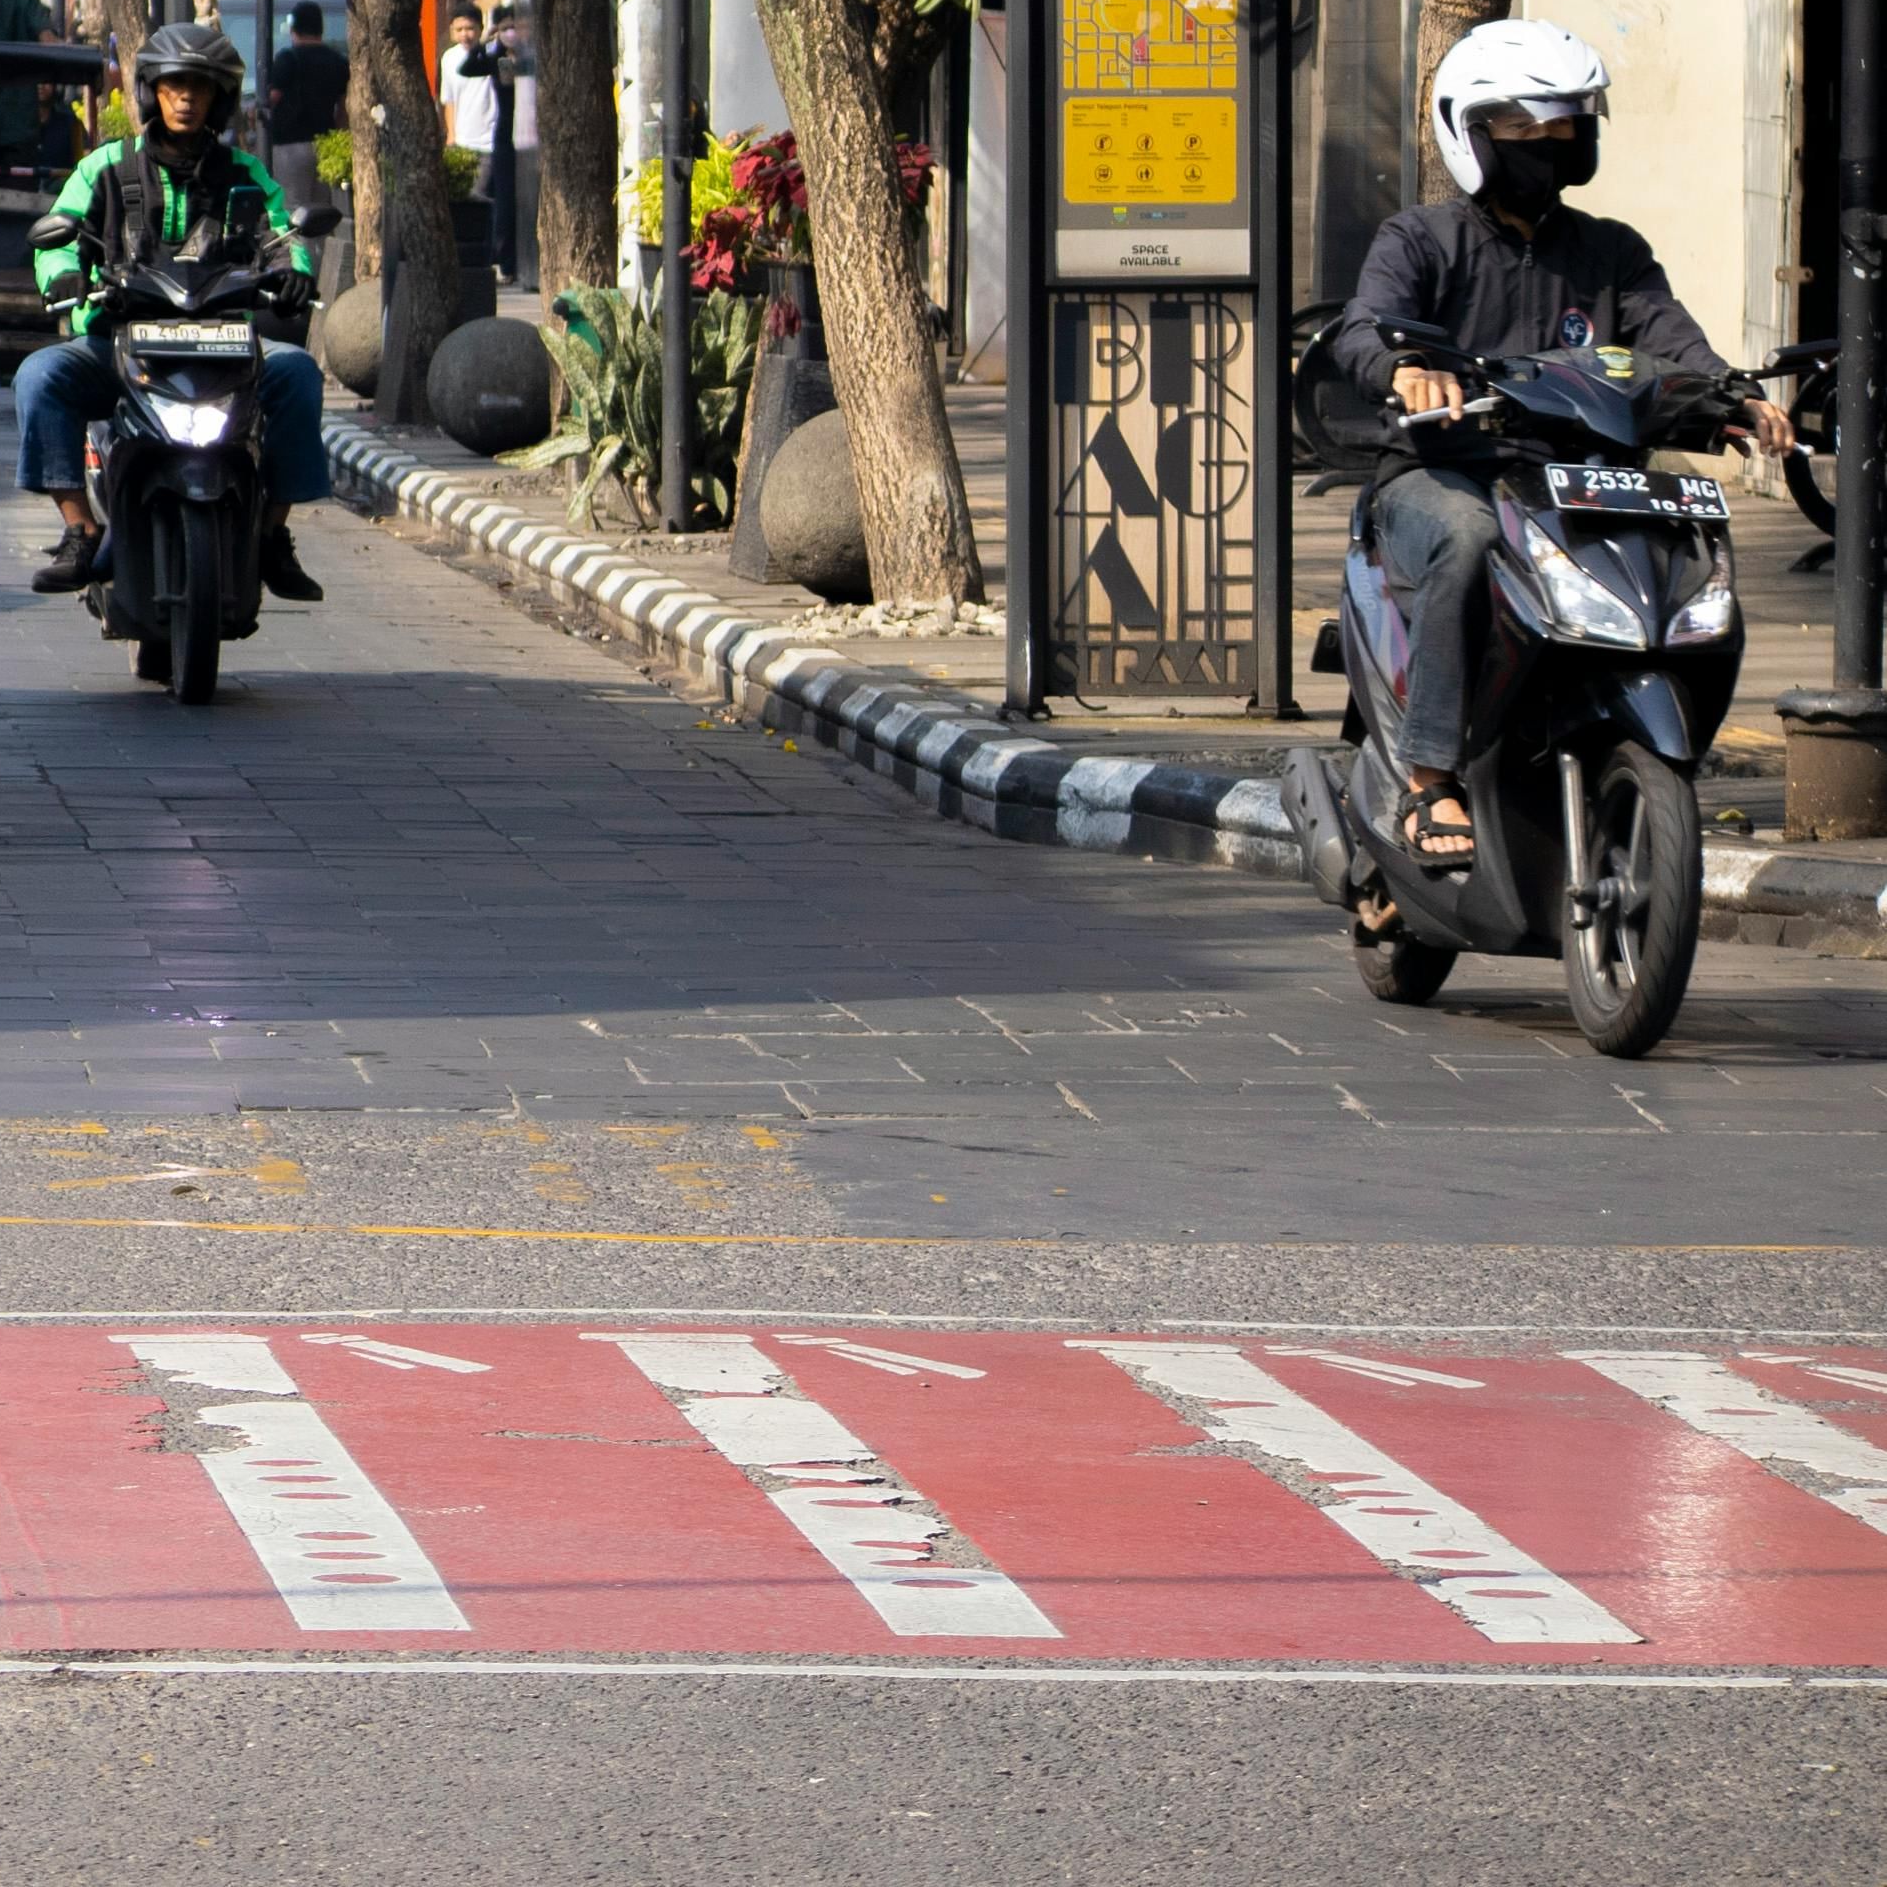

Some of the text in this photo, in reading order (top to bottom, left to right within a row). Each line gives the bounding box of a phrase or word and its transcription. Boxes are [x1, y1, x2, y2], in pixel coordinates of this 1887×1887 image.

[1131, 244, 1170, 255] SPACE
[1119, 255, 1182, 266] AVAILABLE
[1549, 467, 1718, 499] D 2532 MG
